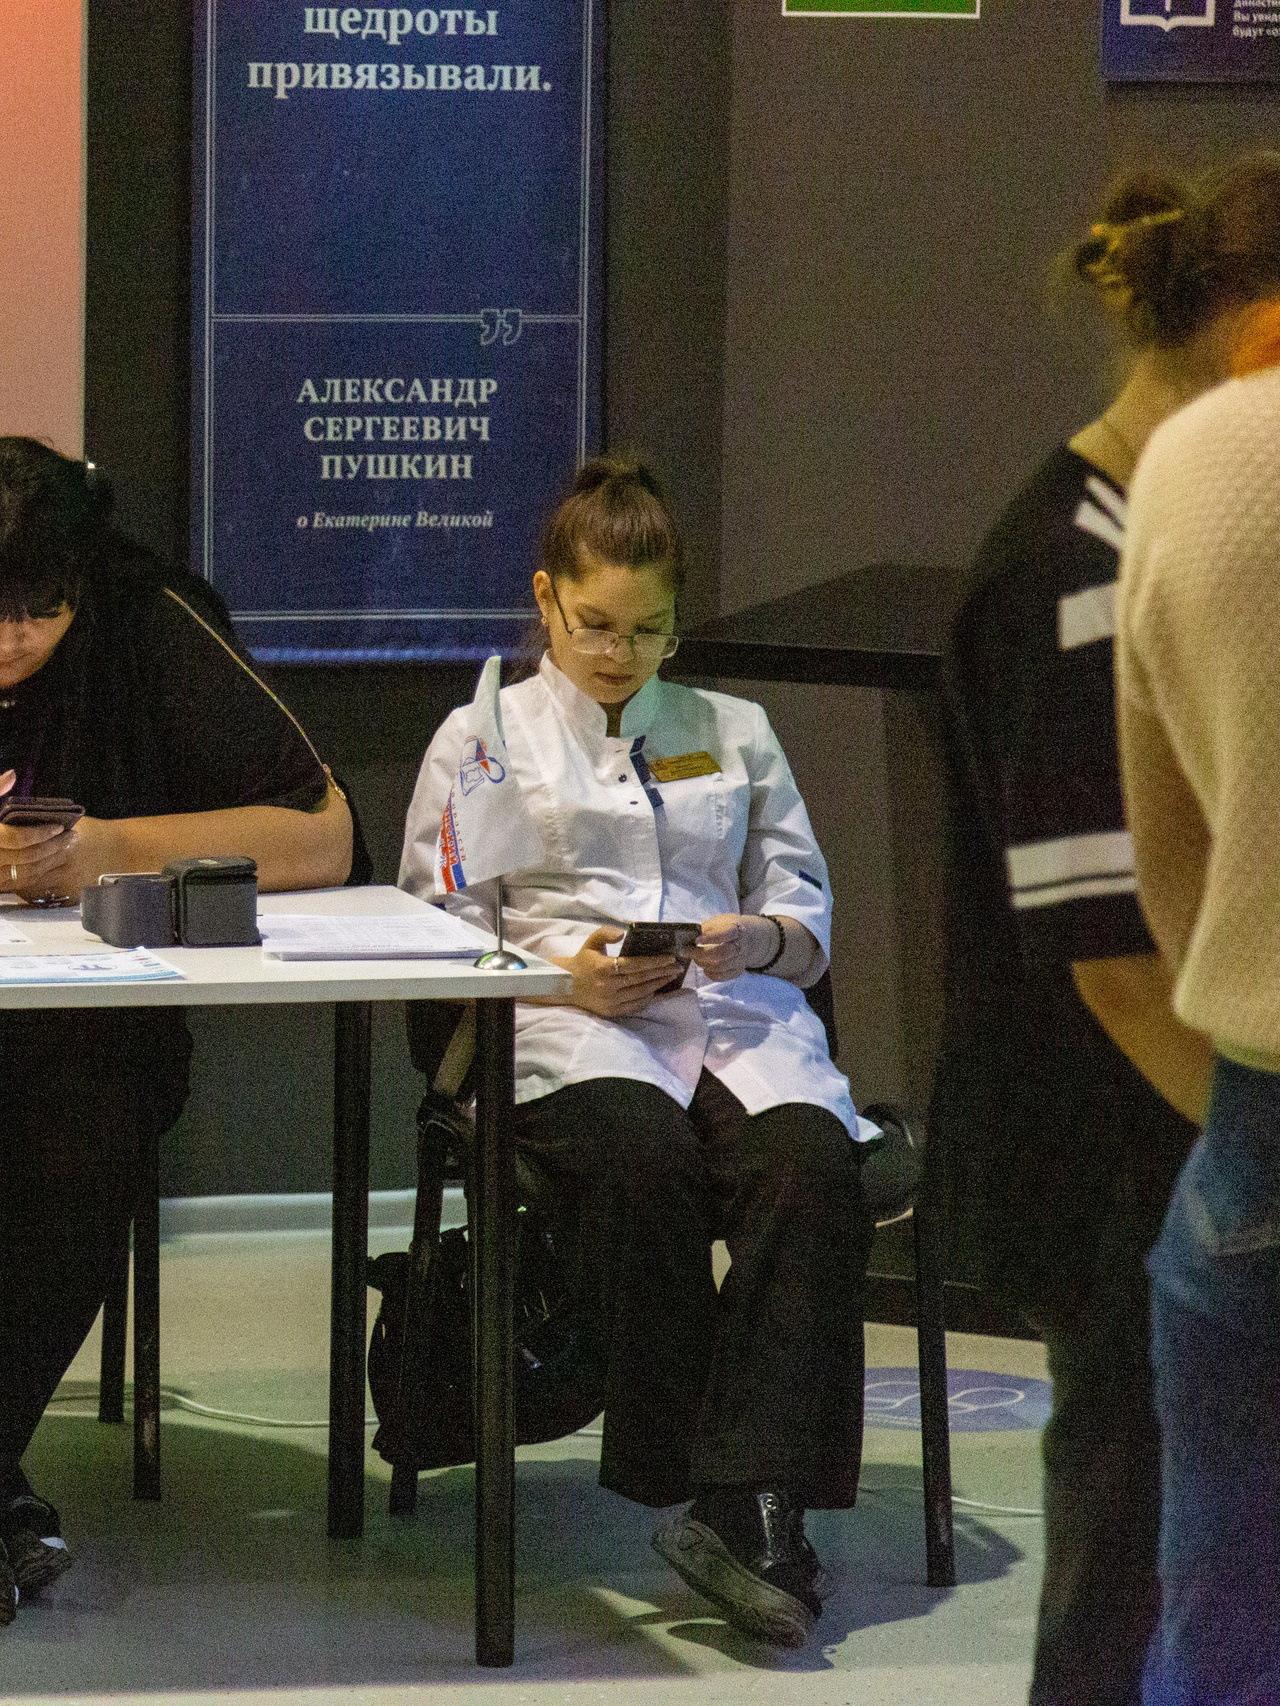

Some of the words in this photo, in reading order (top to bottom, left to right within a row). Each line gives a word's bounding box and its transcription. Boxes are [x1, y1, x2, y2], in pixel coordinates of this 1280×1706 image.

[303, 7, 500, 46] щедроты
[247, 61, 552, 100] привязывали.
[296, 377, 499, 408] АЛЕКСАНДР
[302, 415, 491, 443] СЕРГЕЕВИЧ
[320, 453, 473, 480] ПУШКИН
[296, 515, 309, 529] о
[312, 511, 413, 533] Екатерине
[414, 508, 495, 531] Великой
